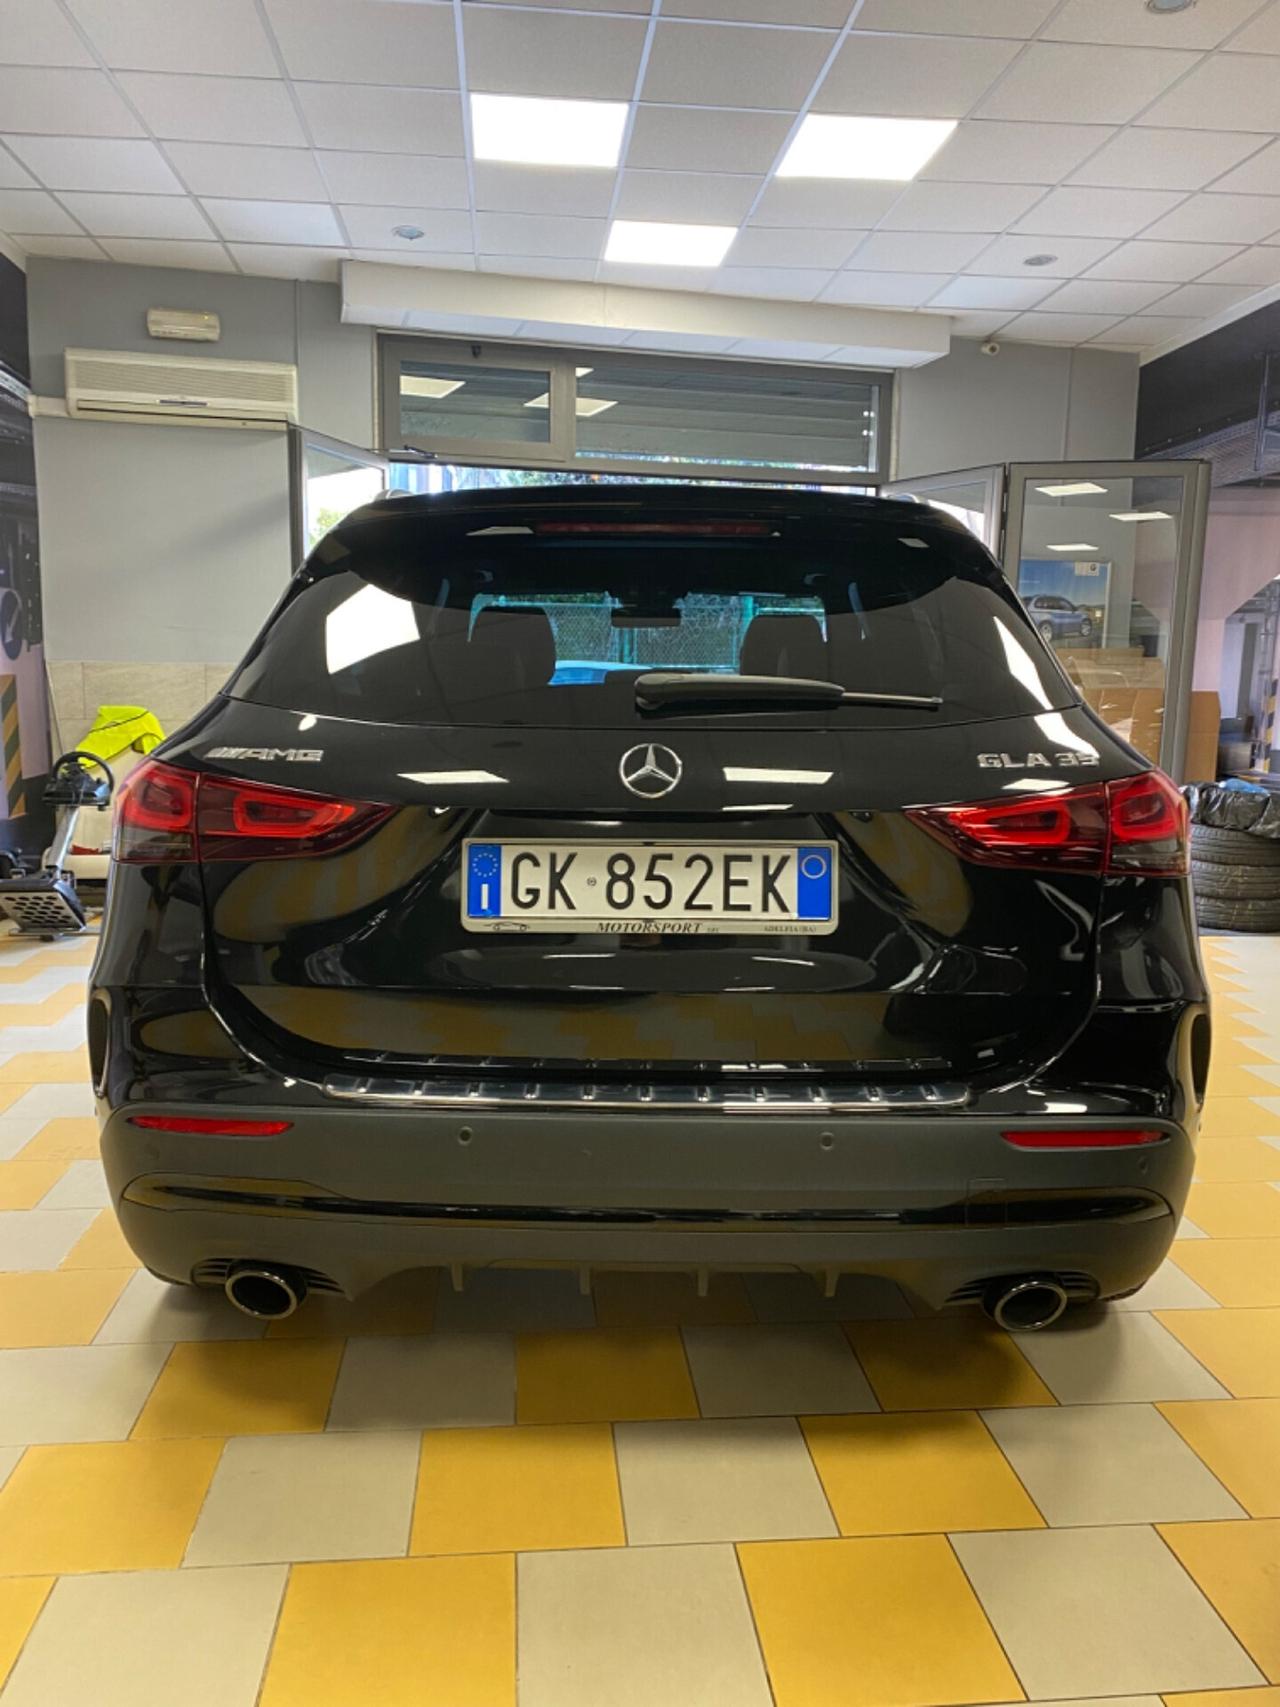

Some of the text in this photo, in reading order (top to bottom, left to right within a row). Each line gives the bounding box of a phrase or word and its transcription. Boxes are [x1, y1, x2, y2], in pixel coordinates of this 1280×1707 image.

[238, 748, 324, 761] AMG
[977, 752, 1052, 768] GLA
[510, 852, 792, 914] GK 852EK
[597, 922, 702, 933] MOTORSPORT
